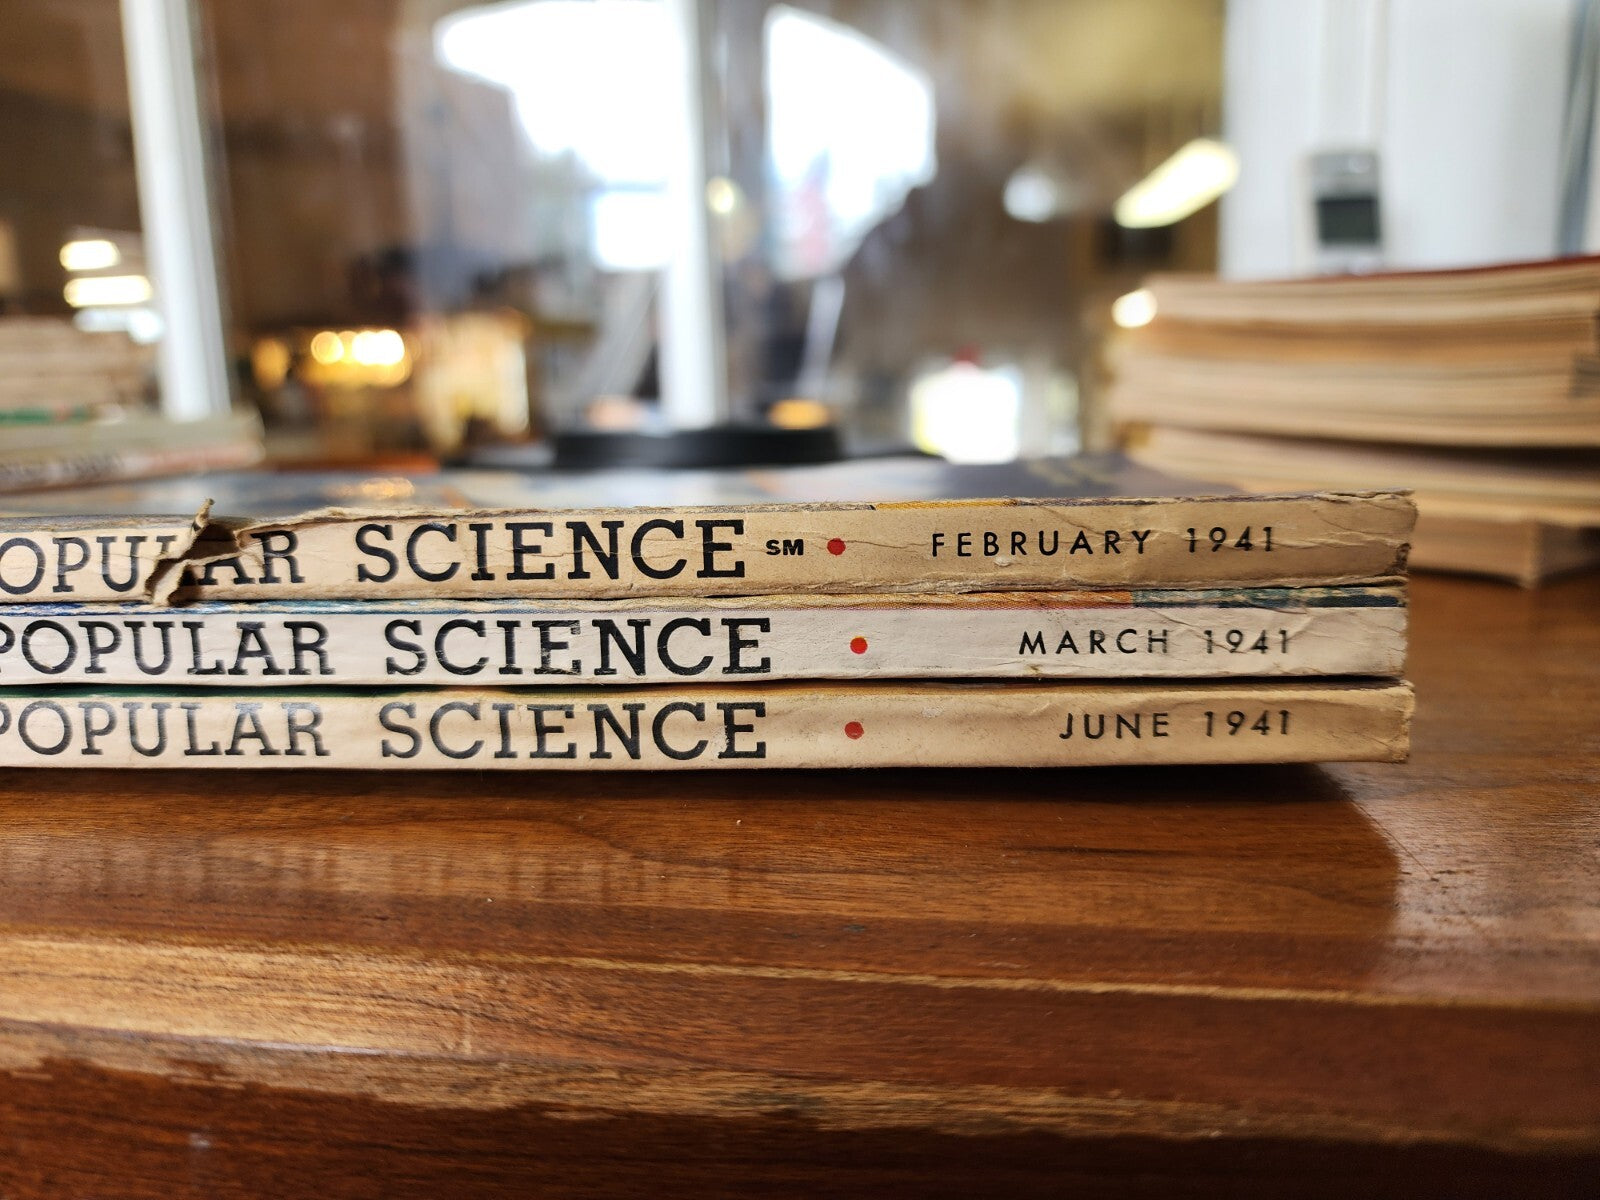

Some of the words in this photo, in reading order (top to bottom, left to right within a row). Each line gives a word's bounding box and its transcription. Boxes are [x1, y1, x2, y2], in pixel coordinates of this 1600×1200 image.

[0, 530, 305, 595] OPUAR
[355, 518, 745, 583] SCIENCE
[765, 538, 804, 556] SM
[931, 529, 1152, 557] FEBRUARY
[1187, 526, 1275, 553] 1941
[384, 617, 771, 676] SCIENCE
[1018, 628, 1169, 655] MARCH
[1203, 629, 1290, 655] 1941
[378, 701, 766, 760] SCIENCE
[1058, 712, 1169, 740] JUNE
[1203, 709, 1291, 737] 1941
